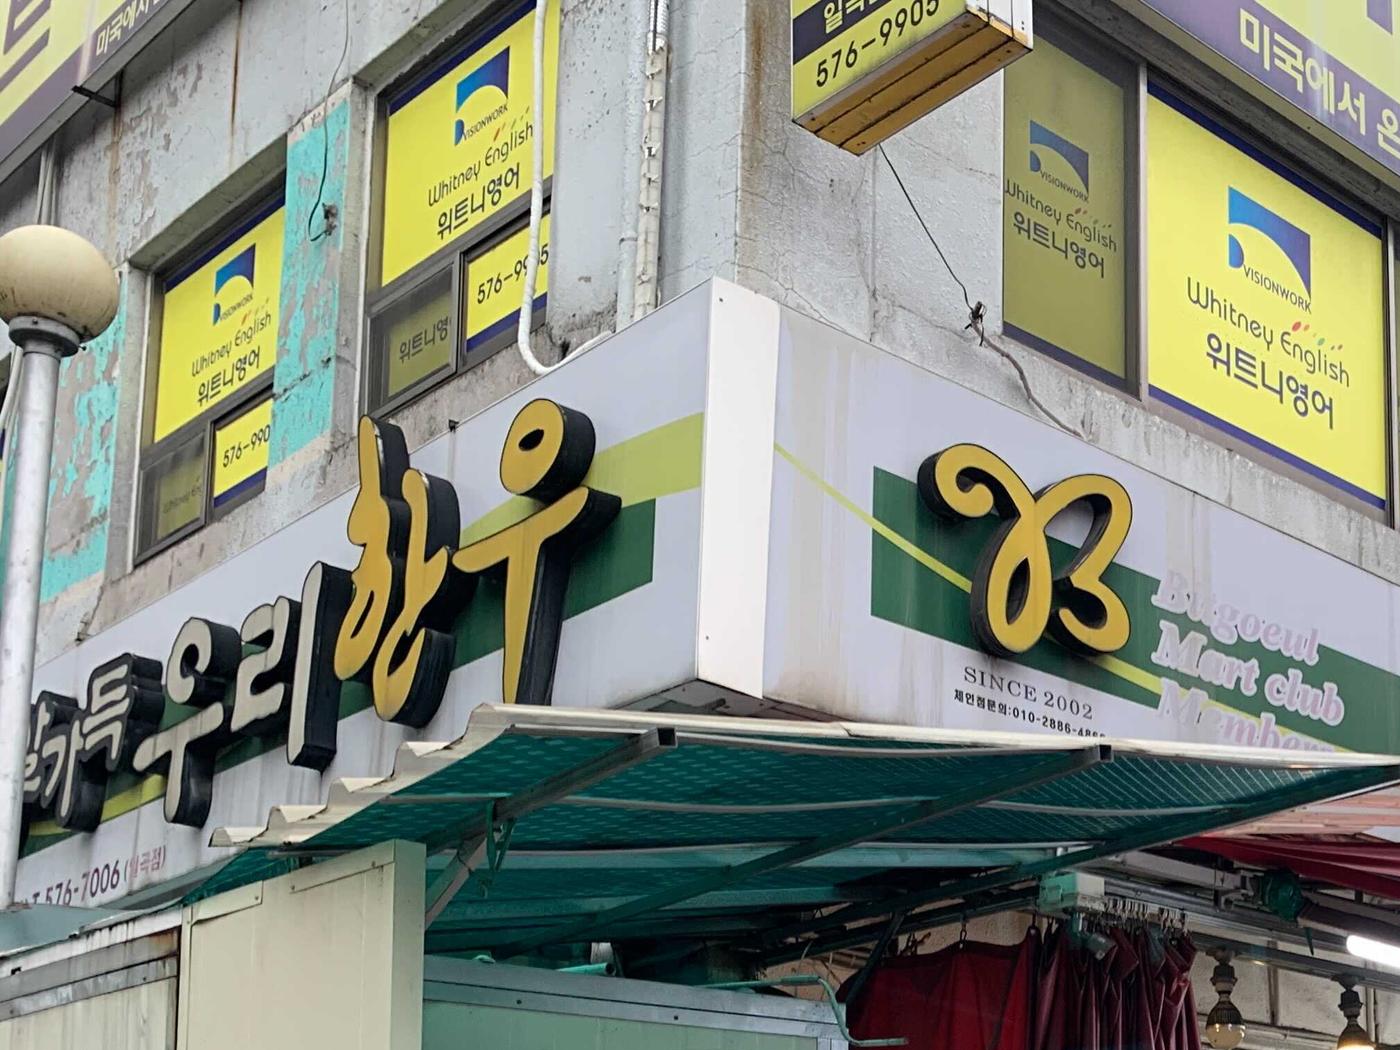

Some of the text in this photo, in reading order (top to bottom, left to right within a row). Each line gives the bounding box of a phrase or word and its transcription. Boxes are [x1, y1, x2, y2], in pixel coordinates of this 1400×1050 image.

[816, 0, 940, 87] 576-9905
[1240, 8, 1366, 135] 미국에서
[428, 121, 534, 207] Whitney English
[437, 162, 520, 240] 위트니영어
[1005, 178, 1117, 252] Whitney English
[1014, 211, 1105, 279] 위트니영어
[477, 243, 550, 304] 576-995
[1242, 263, 1312, 315] VISIONWORK
[192, 312, 272, 378] Whitney English
[1187, 276, 1350, 388] Whitney English
[197, 345, 261, 407] 위트니영어
[1206, 333, 1334, 431] 위트니영어
[133, 561, 345, 826] 우리
[964, 666, 1093, 720] SINCE 2002
[1151, 619, 1345, 726] Mart club
